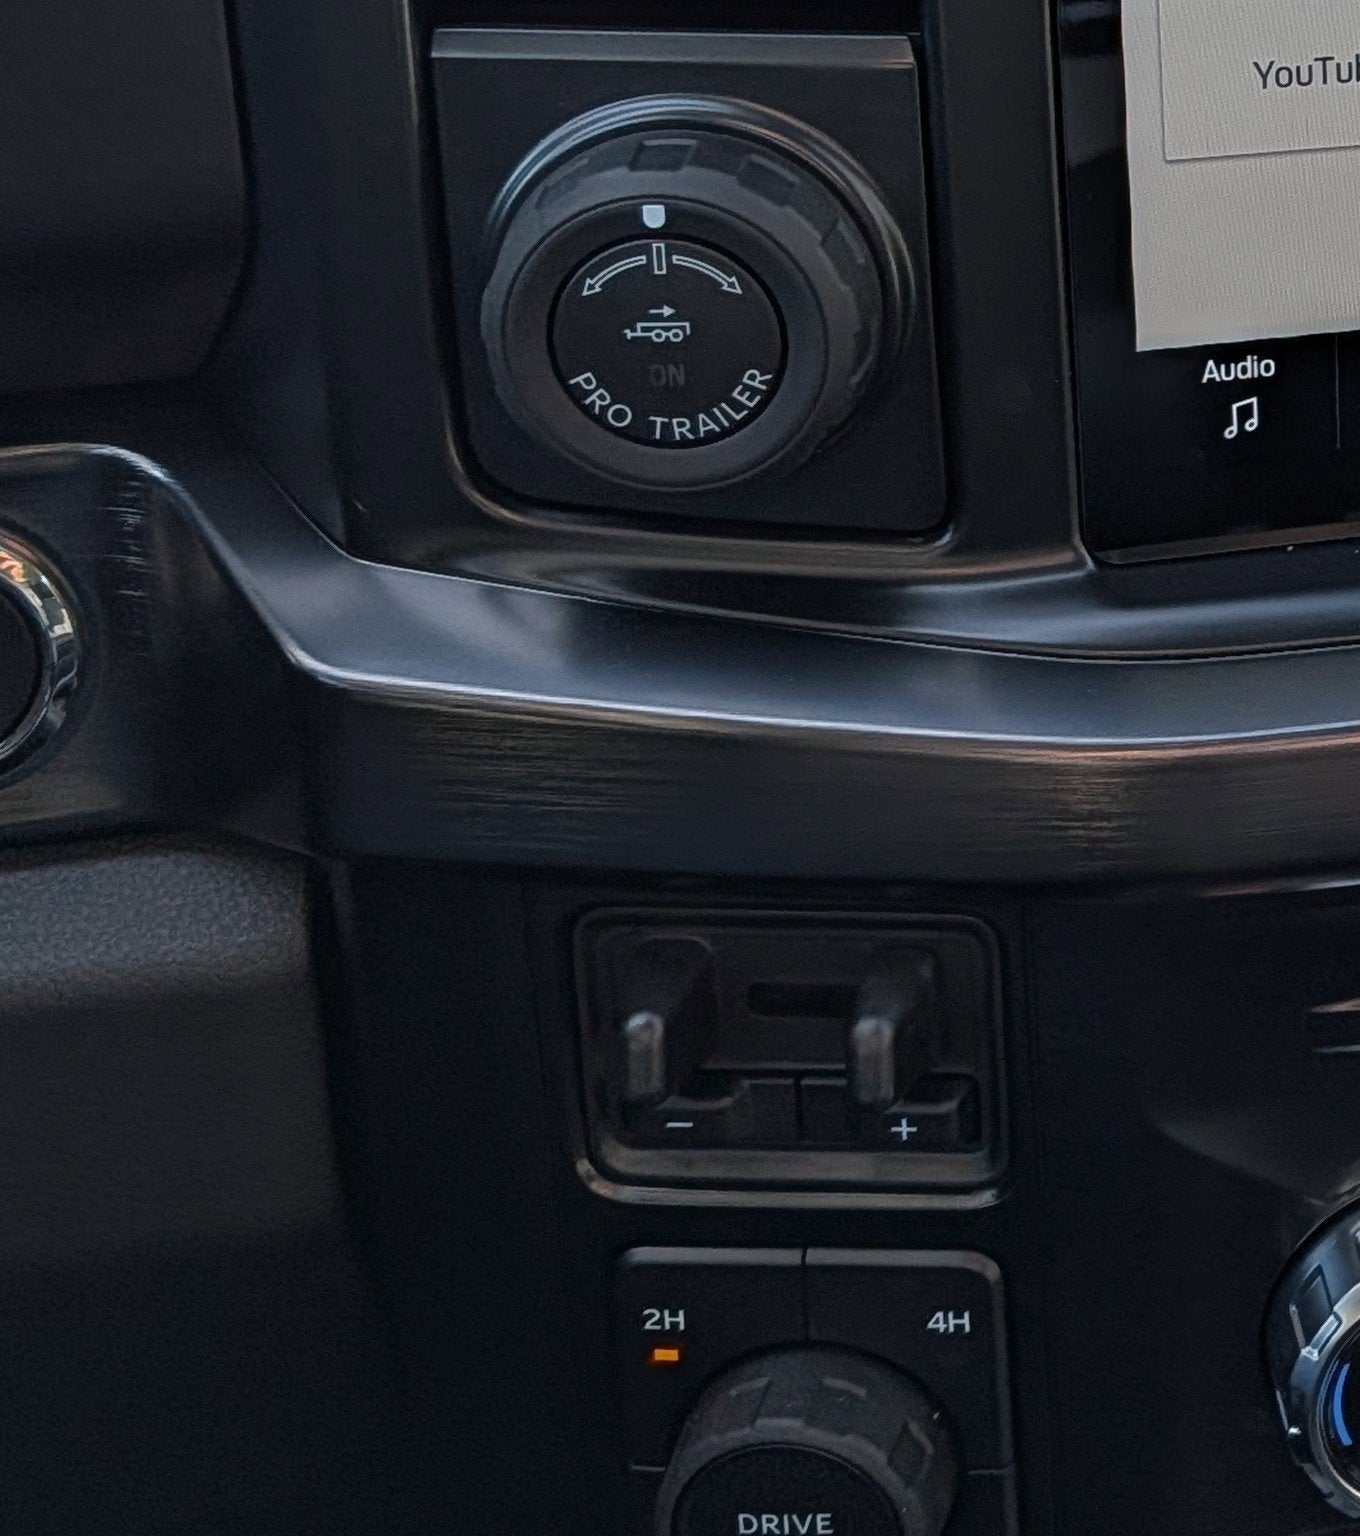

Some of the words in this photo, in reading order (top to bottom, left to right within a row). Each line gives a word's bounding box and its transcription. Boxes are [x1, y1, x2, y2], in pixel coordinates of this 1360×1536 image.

[651, 363, 687, 389] ON
[1200, 355, 1277, 385] Audio
[568, 370, 635, 430] PRO
[648, 366, 775, 442] TRAILER
[641, 1307, 687, 1332] 2H
[925, 1310, 972, 1334] 4H
[736, 1512, 835, 1536] DRIVE
